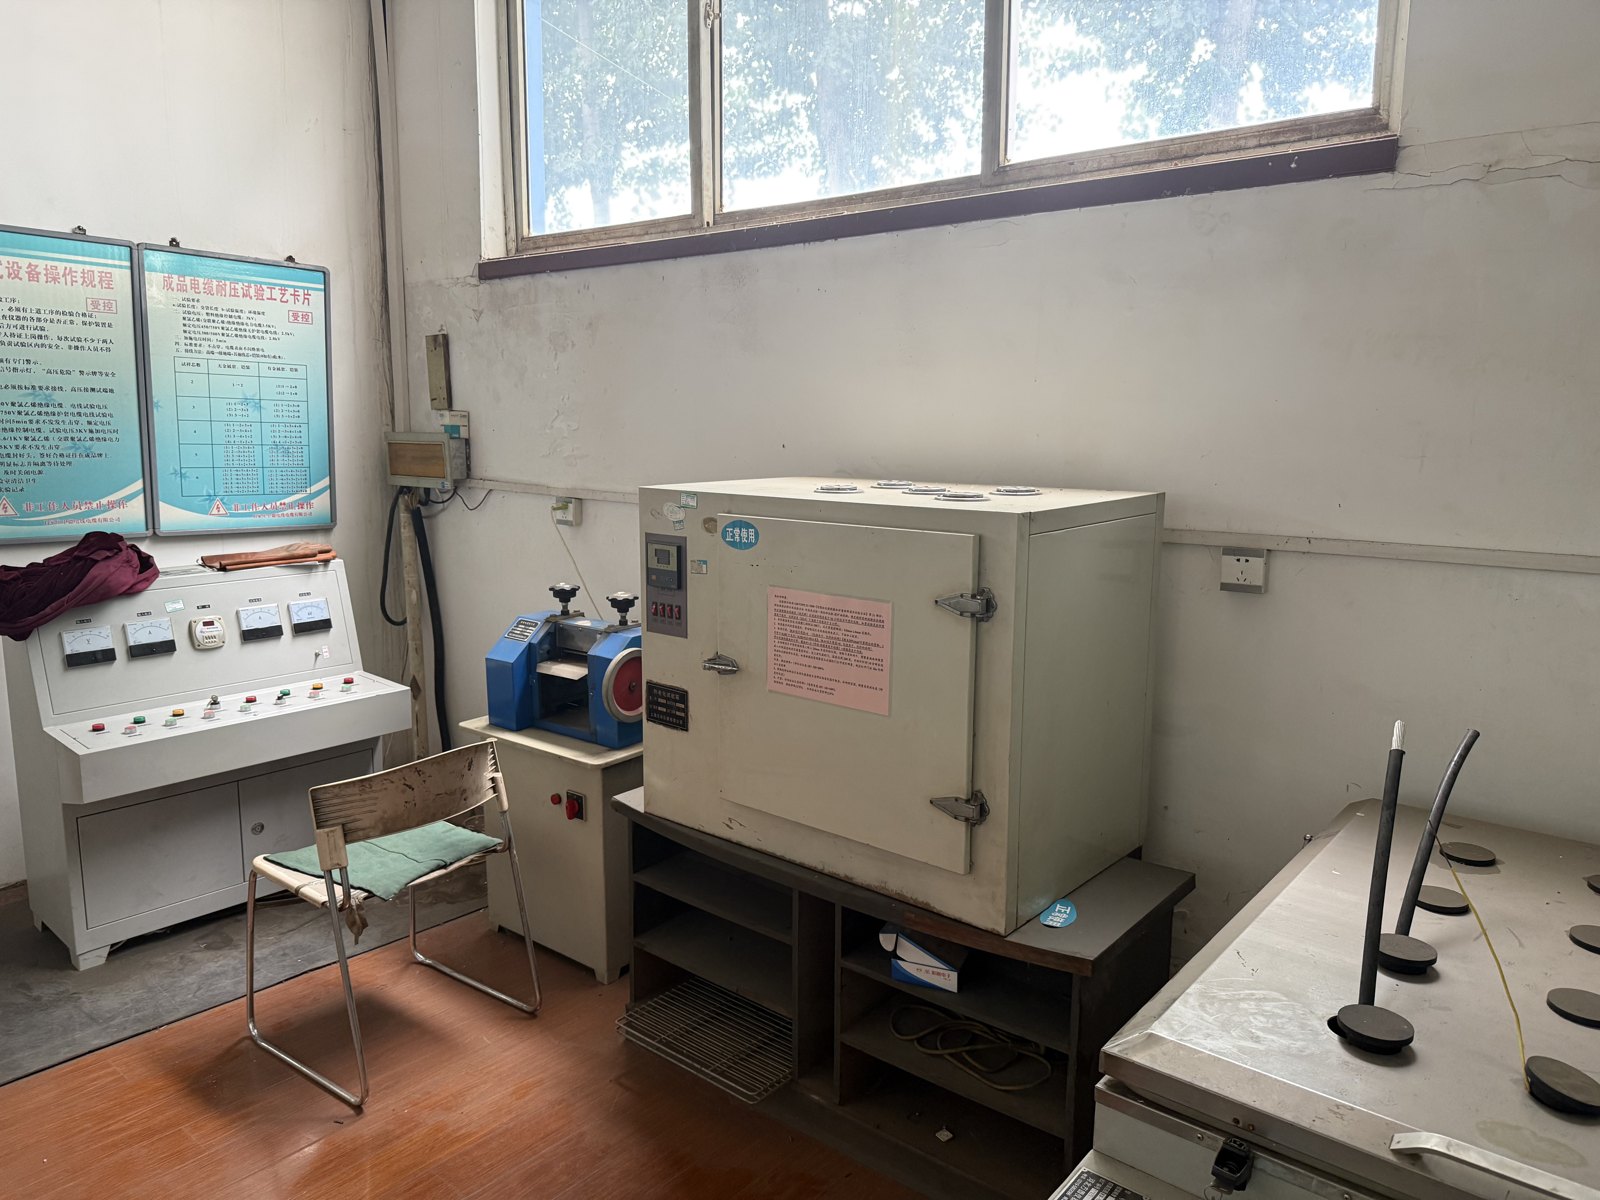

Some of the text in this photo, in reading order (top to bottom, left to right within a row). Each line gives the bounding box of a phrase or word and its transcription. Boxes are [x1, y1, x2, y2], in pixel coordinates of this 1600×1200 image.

[0, 260, 114, 290] 设备操作规程
[162, 275, 312, 307] 成品电缆耐压试验工艺卡片
[90, 300, 114, 311] 受控
[291, 312, 310, 323] 受控
[24, 501, 128, 513] 非工作人员禁止操作
[233, 501, 314, 511] 非工作人员禁止操作
[725, 527, 755, 543] 正常使用
